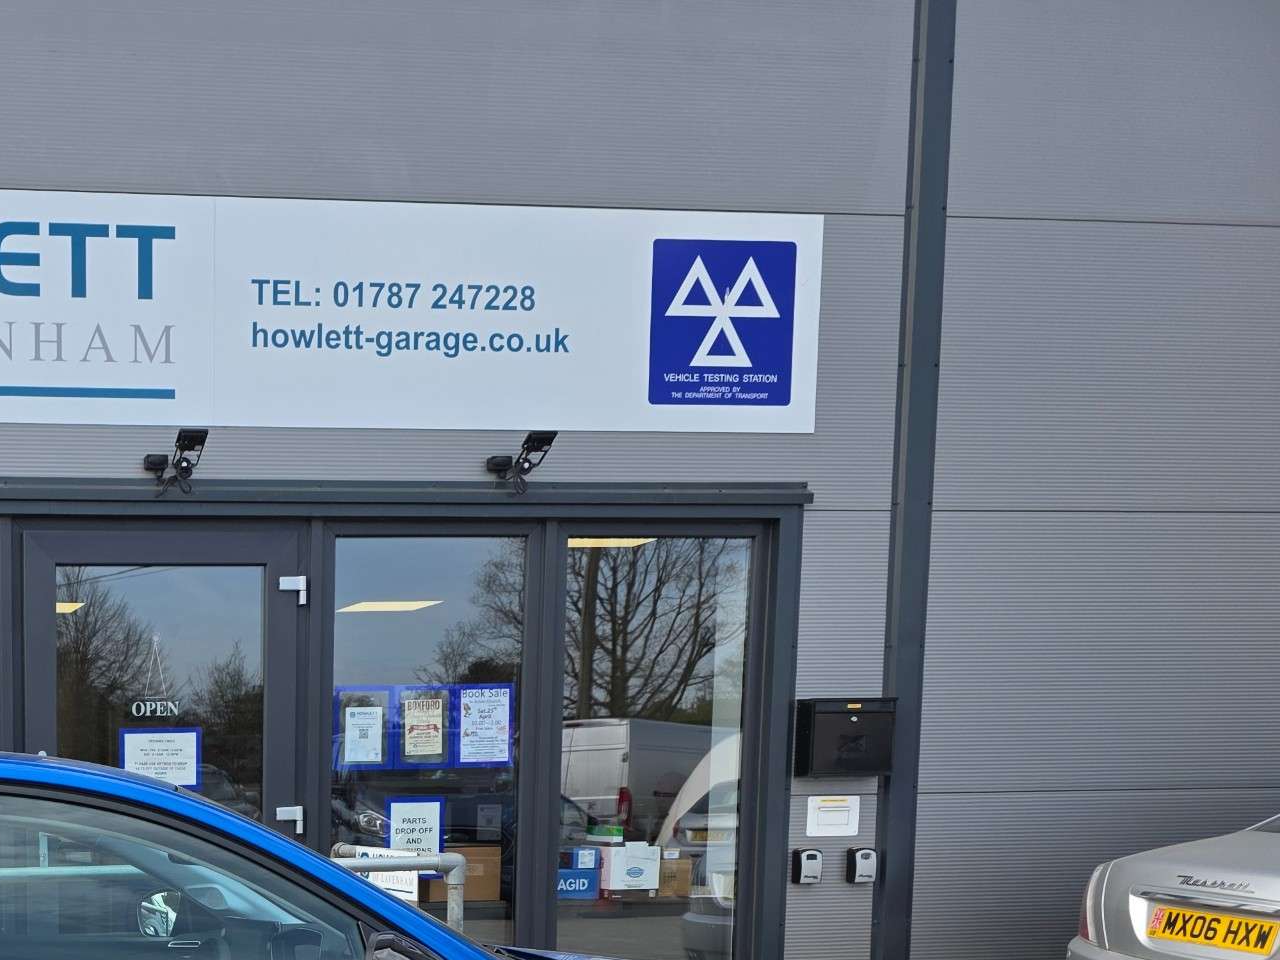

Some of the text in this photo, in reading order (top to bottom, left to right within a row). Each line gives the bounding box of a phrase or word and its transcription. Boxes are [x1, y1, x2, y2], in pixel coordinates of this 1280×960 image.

[251, 279, 535, 311] TEL: 01787 247228
[251, 322, 569, 358] howlett-garage.co.uk
[664, 373, 777, 383] VEHICLE TESTING STATION
[488, 689, 507, 698] Sale
[131, 701, 179, 717] OPEN
[402, 817, 427, 825] PARTS
[406, 837, 423, 845] AND
[1162, 911, 1274, 949] MX06 HXW
